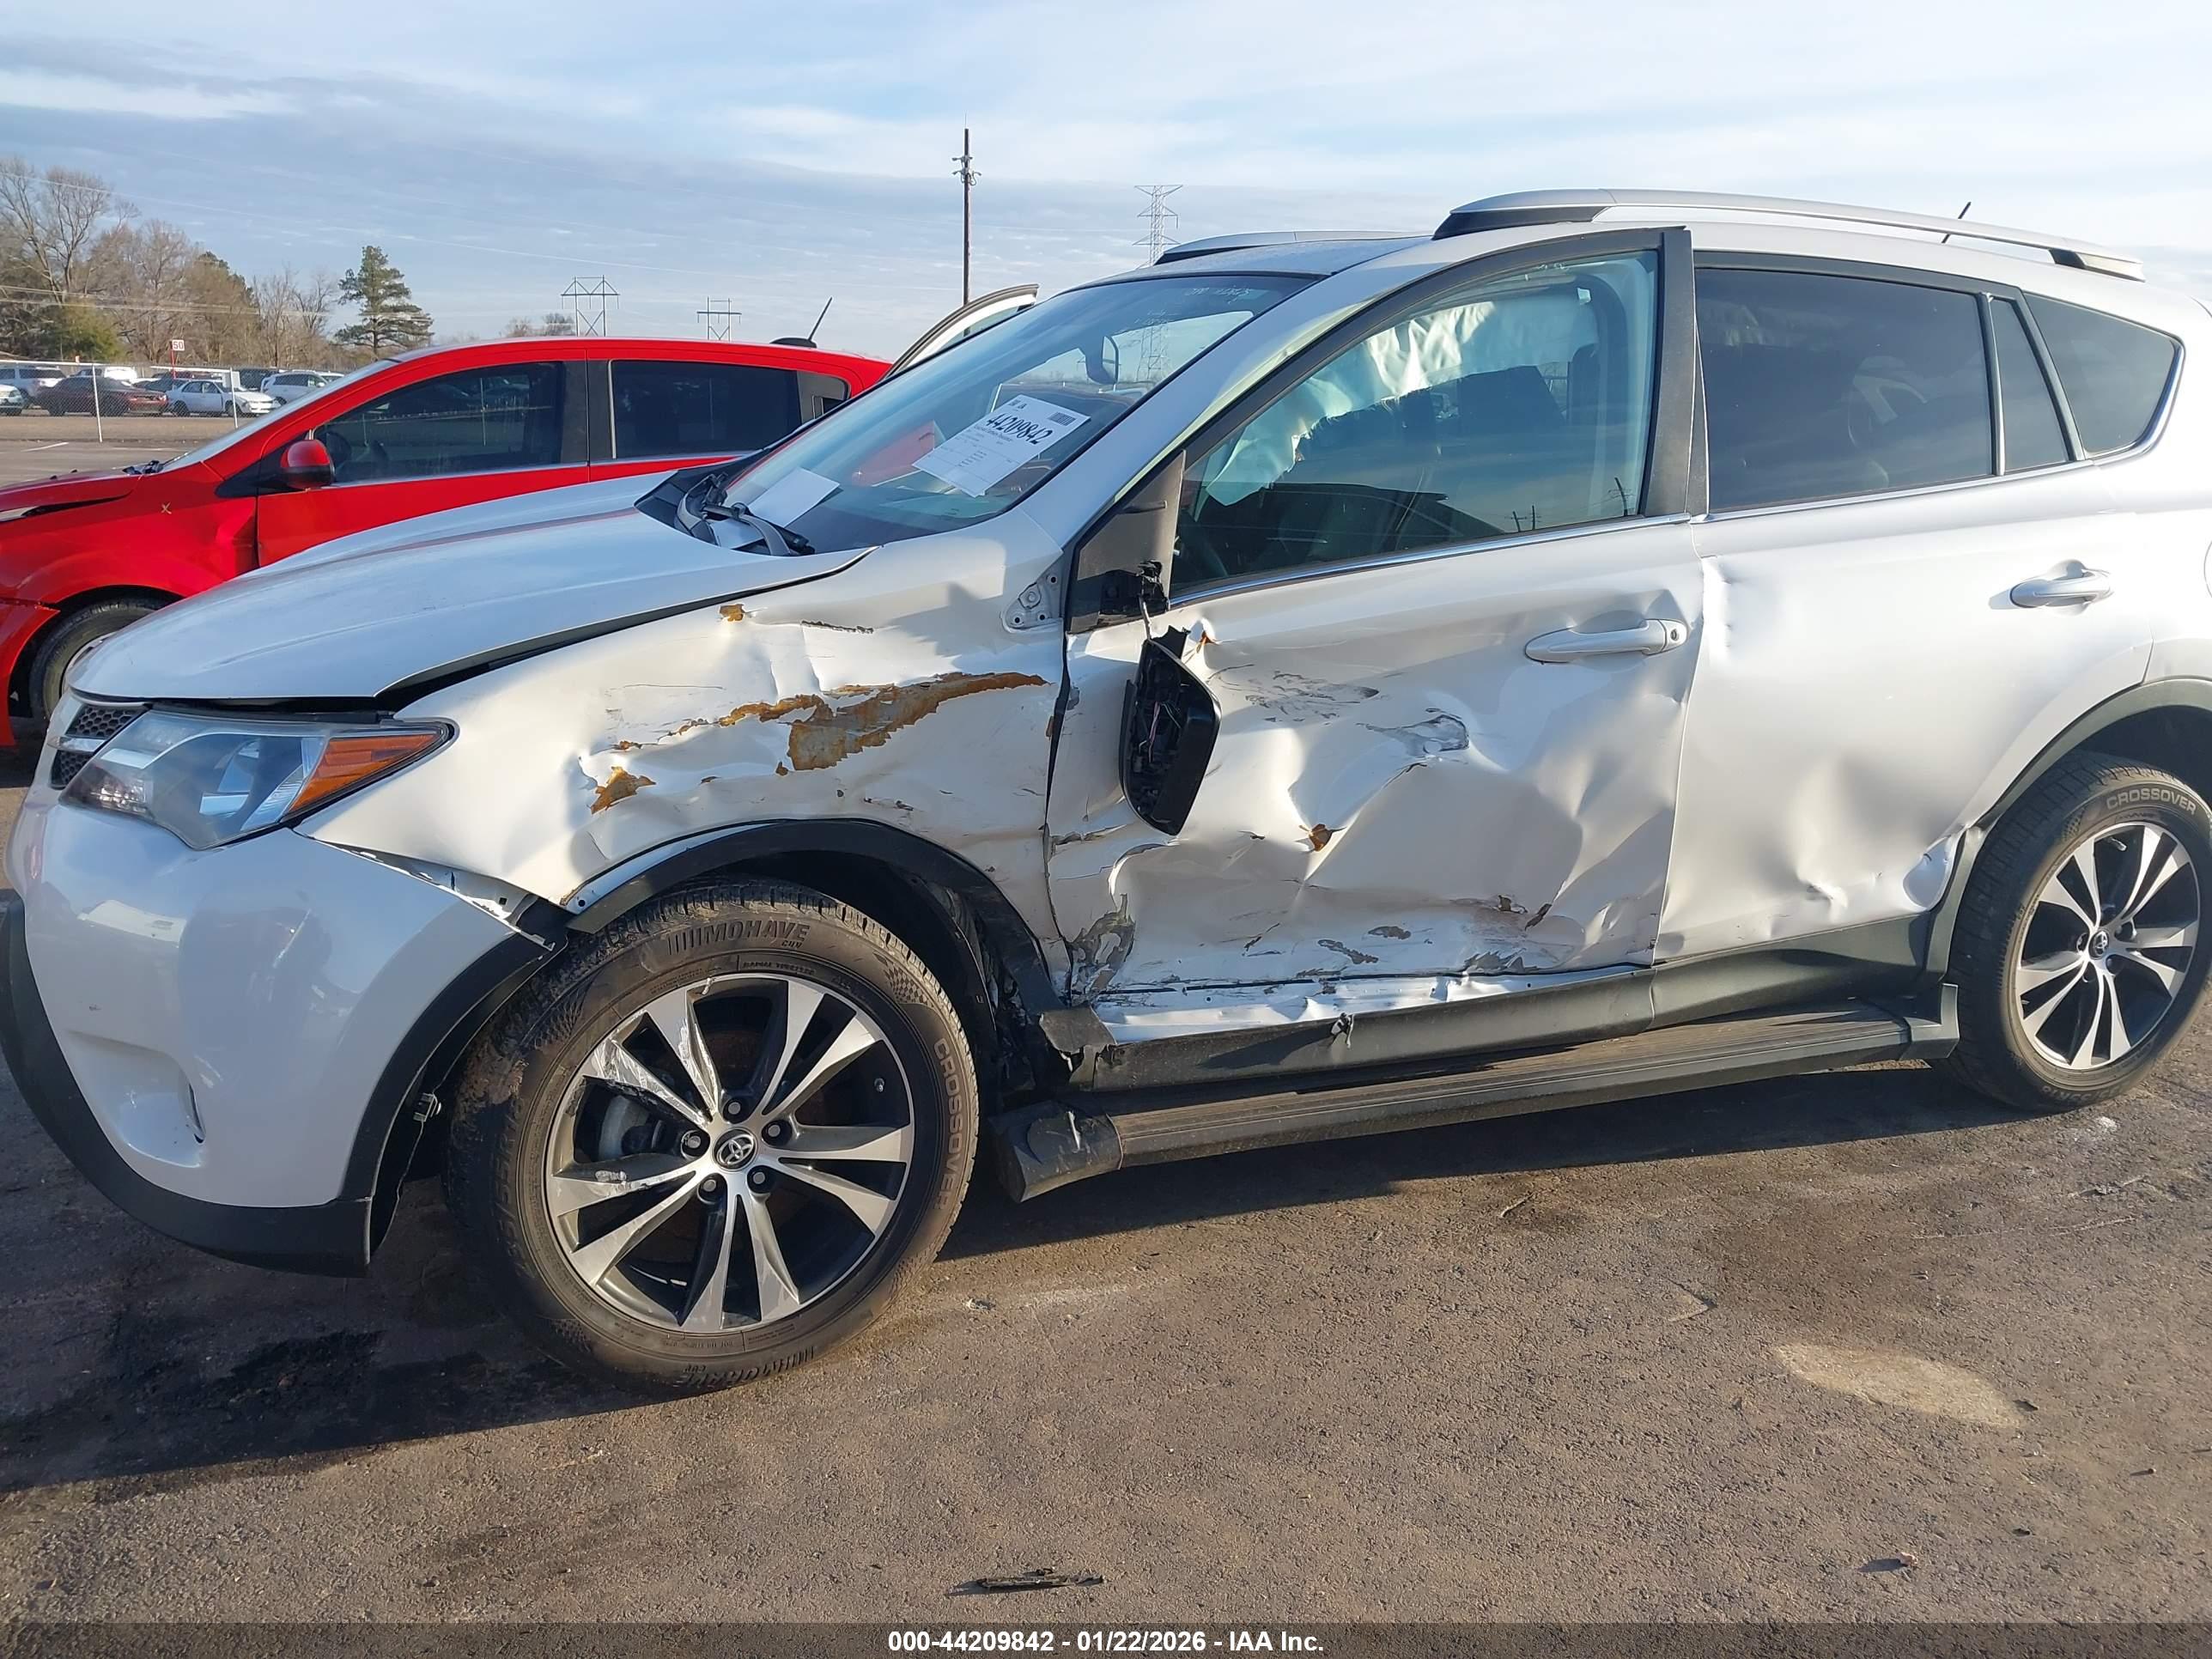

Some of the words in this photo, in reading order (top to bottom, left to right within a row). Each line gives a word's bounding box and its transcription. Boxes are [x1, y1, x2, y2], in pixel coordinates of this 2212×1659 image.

[173, 341, 184, 349] 50
[986, 412, 1054, 445] 44209842
[2106, 788, 2197, 815] CROSSOVER
[706, 920, 810, 943] MOHAVE
[934, 1038, 963, 1209] CROSSOVER
